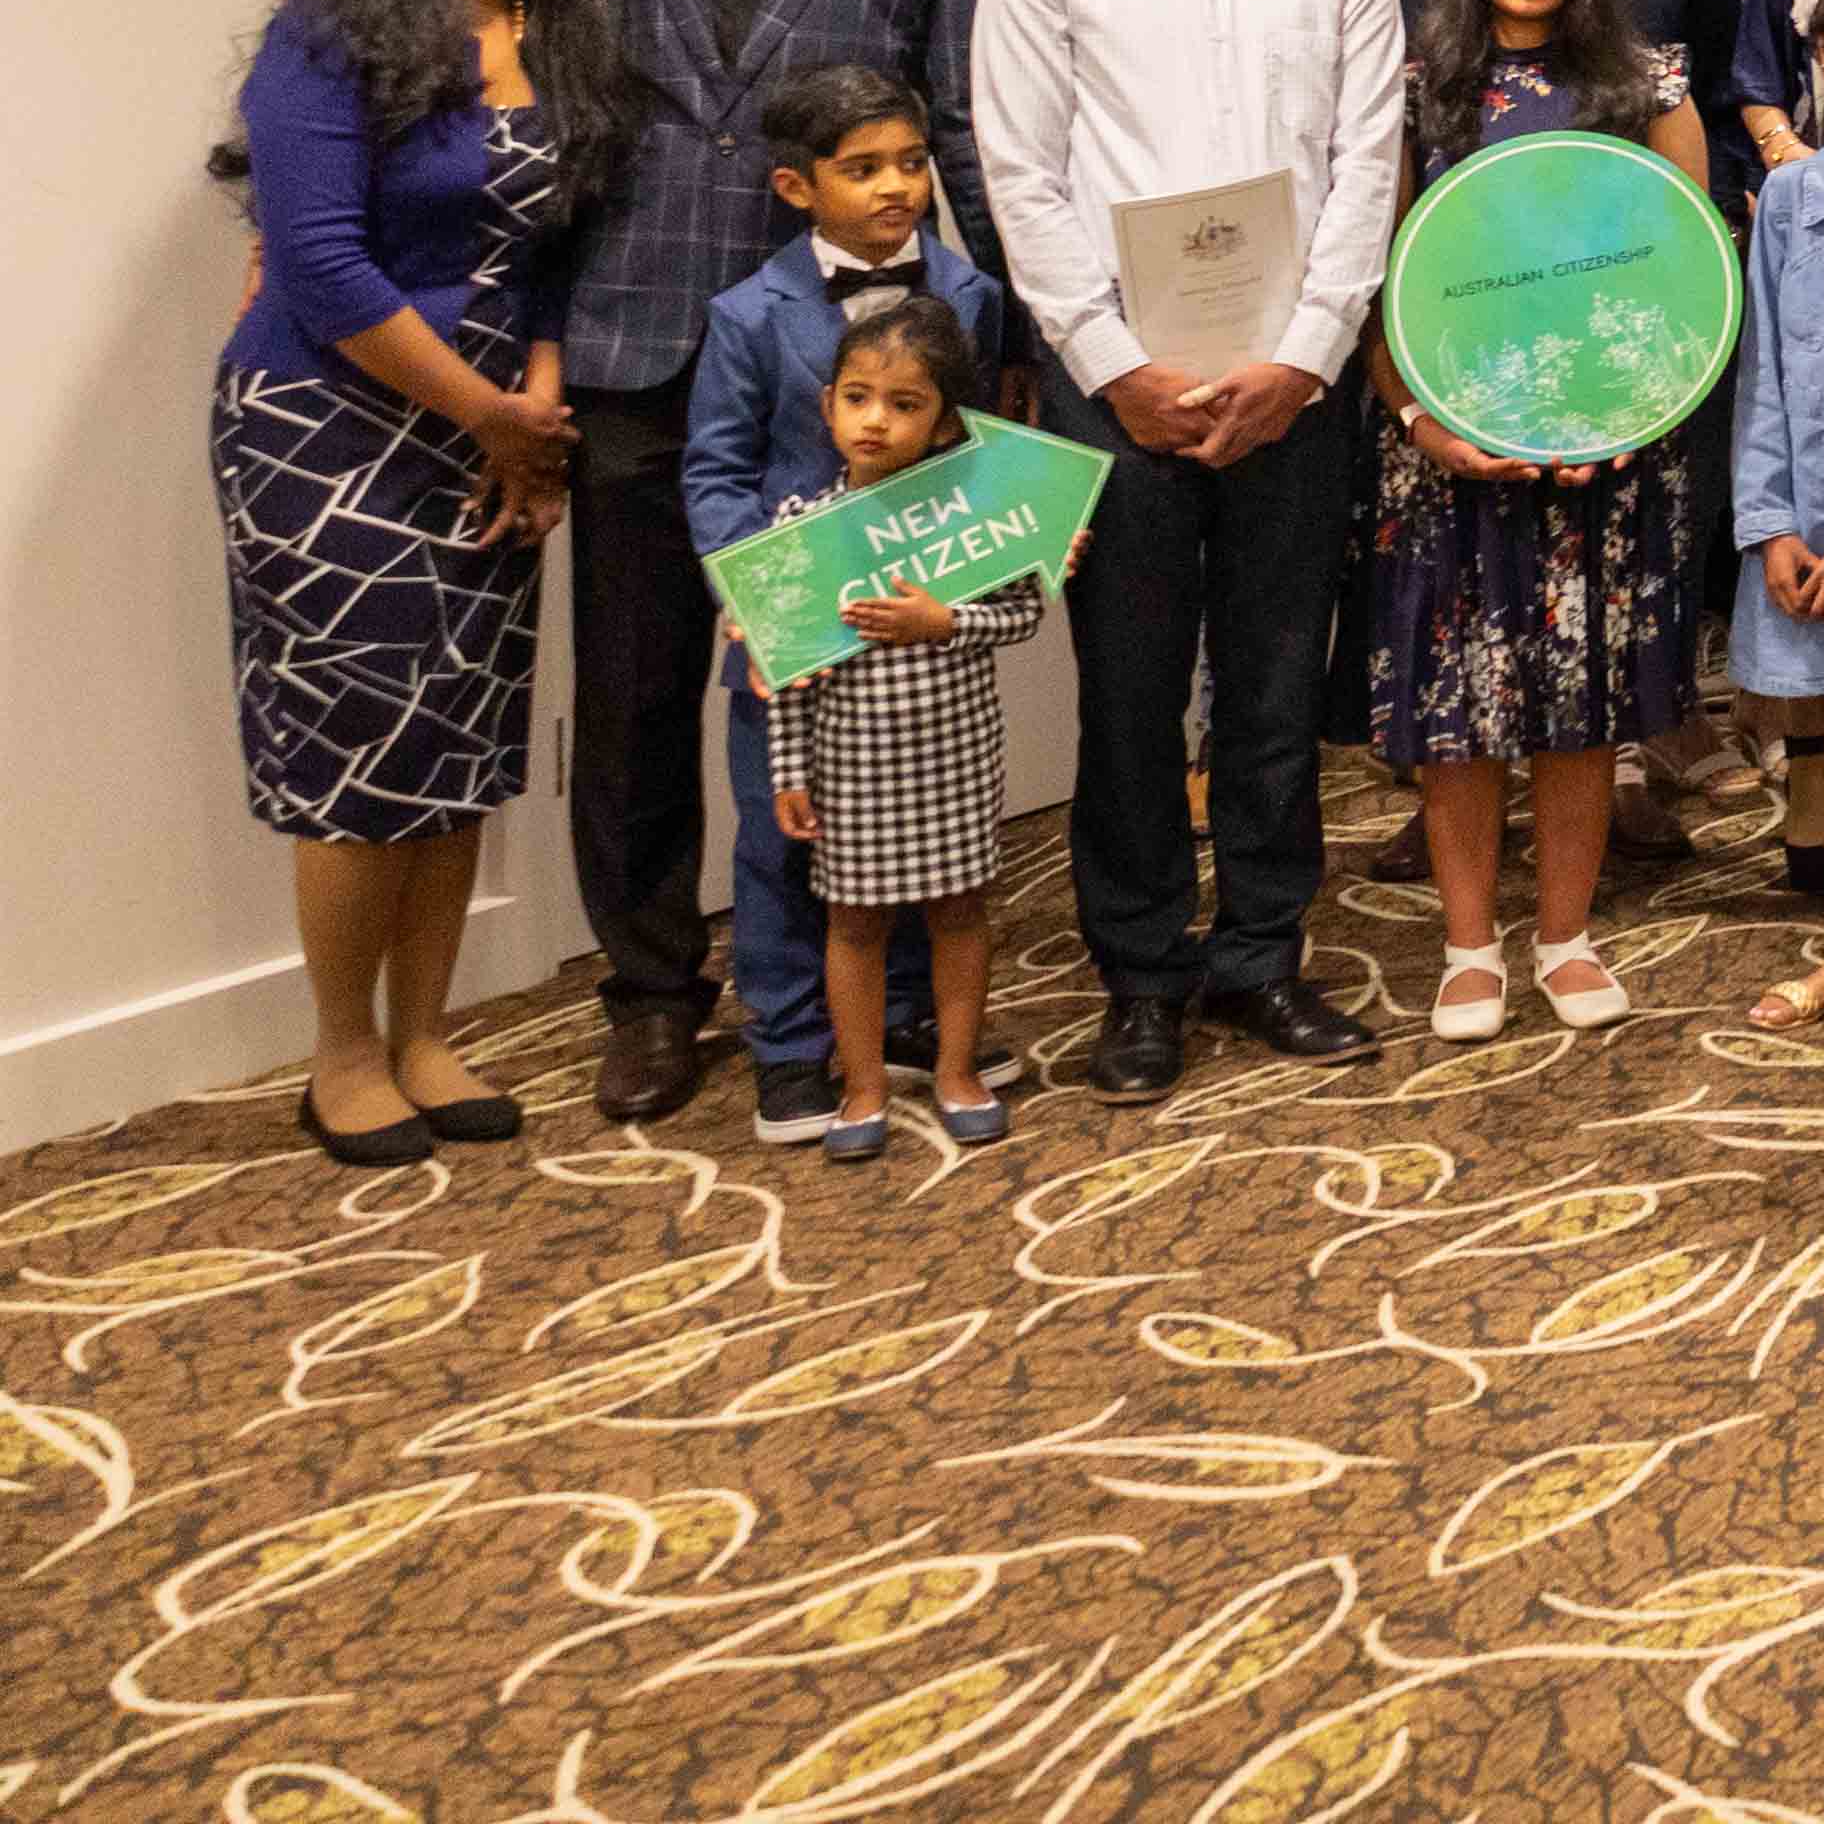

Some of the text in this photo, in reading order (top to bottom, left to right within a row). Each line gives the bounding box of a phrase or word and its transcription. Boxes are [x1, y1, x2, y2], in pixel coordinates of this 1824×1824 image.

[1441, 243, 1655, 300] AUSTRALIAN CITIZENSHIP
[864, 484, 972, 555] NEW
